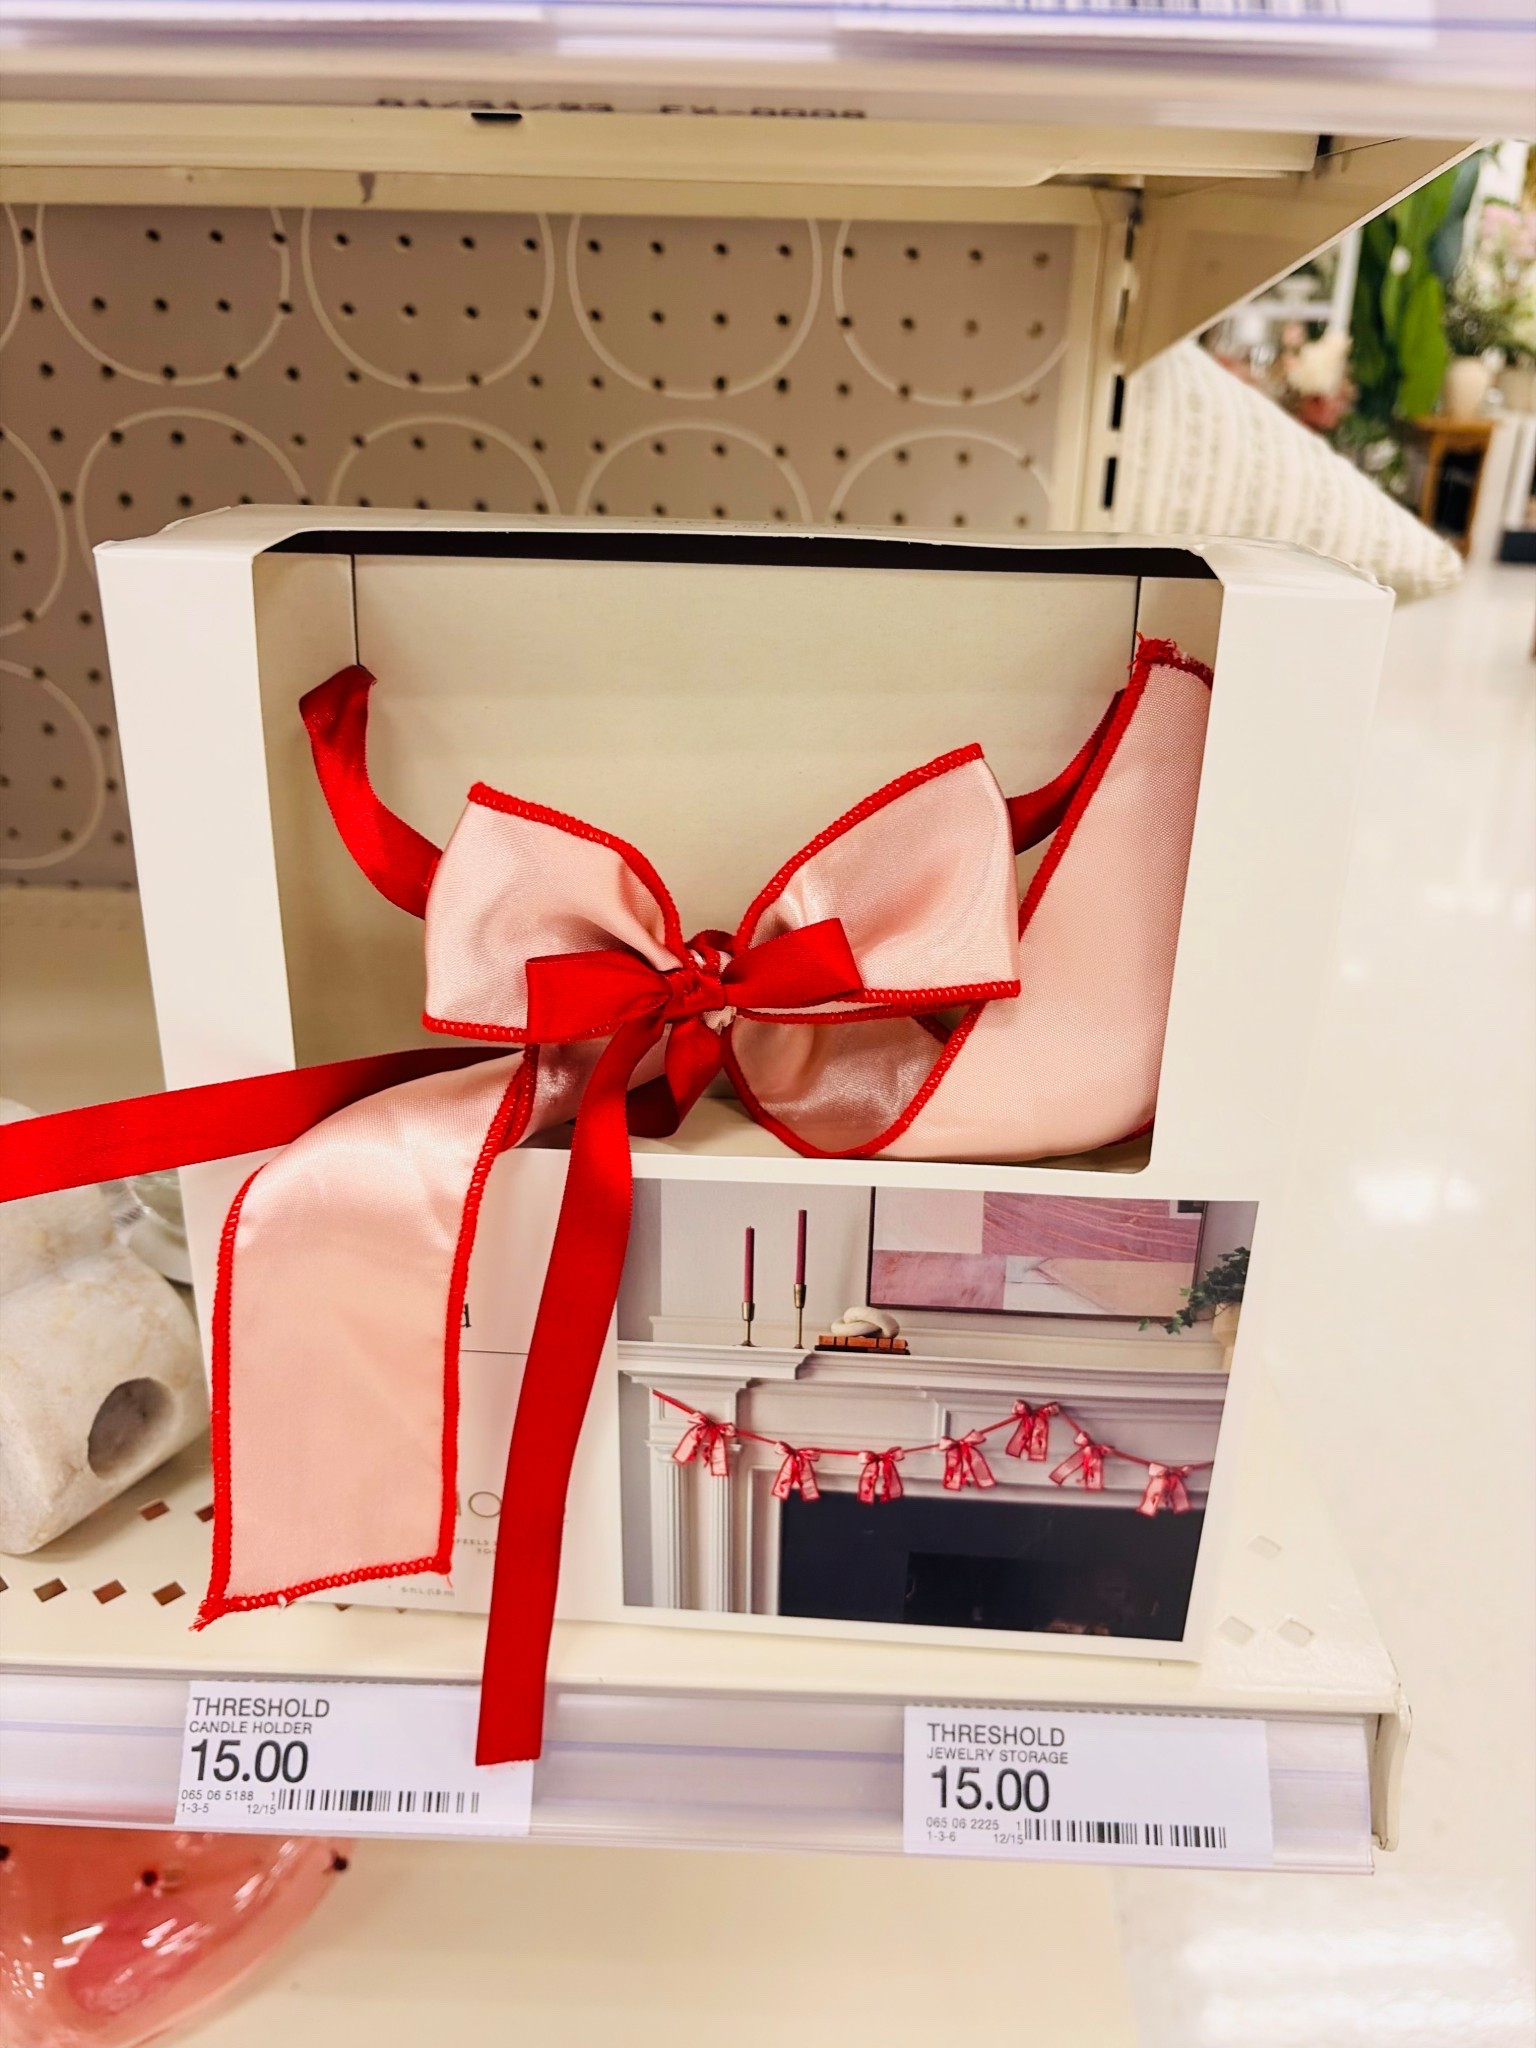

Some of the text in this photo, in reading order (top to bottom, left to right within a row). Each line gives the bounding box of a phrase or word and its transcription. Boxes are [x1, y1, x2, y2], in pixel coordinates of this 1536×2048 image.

[192, 1697, 330, 1718] THRESHOLD
[189, 1720, 312, 1734] CANDLE HOLDER
[927, 1723, 1065, 1747] THRESHOLD
[190, 1738, 309, 1783] 15.00
[927, 1747, 1069, 1764] JEWELRY STORAGE
[181, 1789, 202, 1800] 065
[207, 1790, 221, 1800] 06
[225, 1790, 254, 1801] 5188
[931, 1765, 1050, 1813] 15.00
[181, 1803, 276, 1815] 1-3-5 12/15
[926, 1816, 947, 1827] 065
[952, 1818, 967, 1828] 06
[970, 1818, 999, 1830] 2225
[927, 1830, 1024, 1845] 1-3-6 12/15
